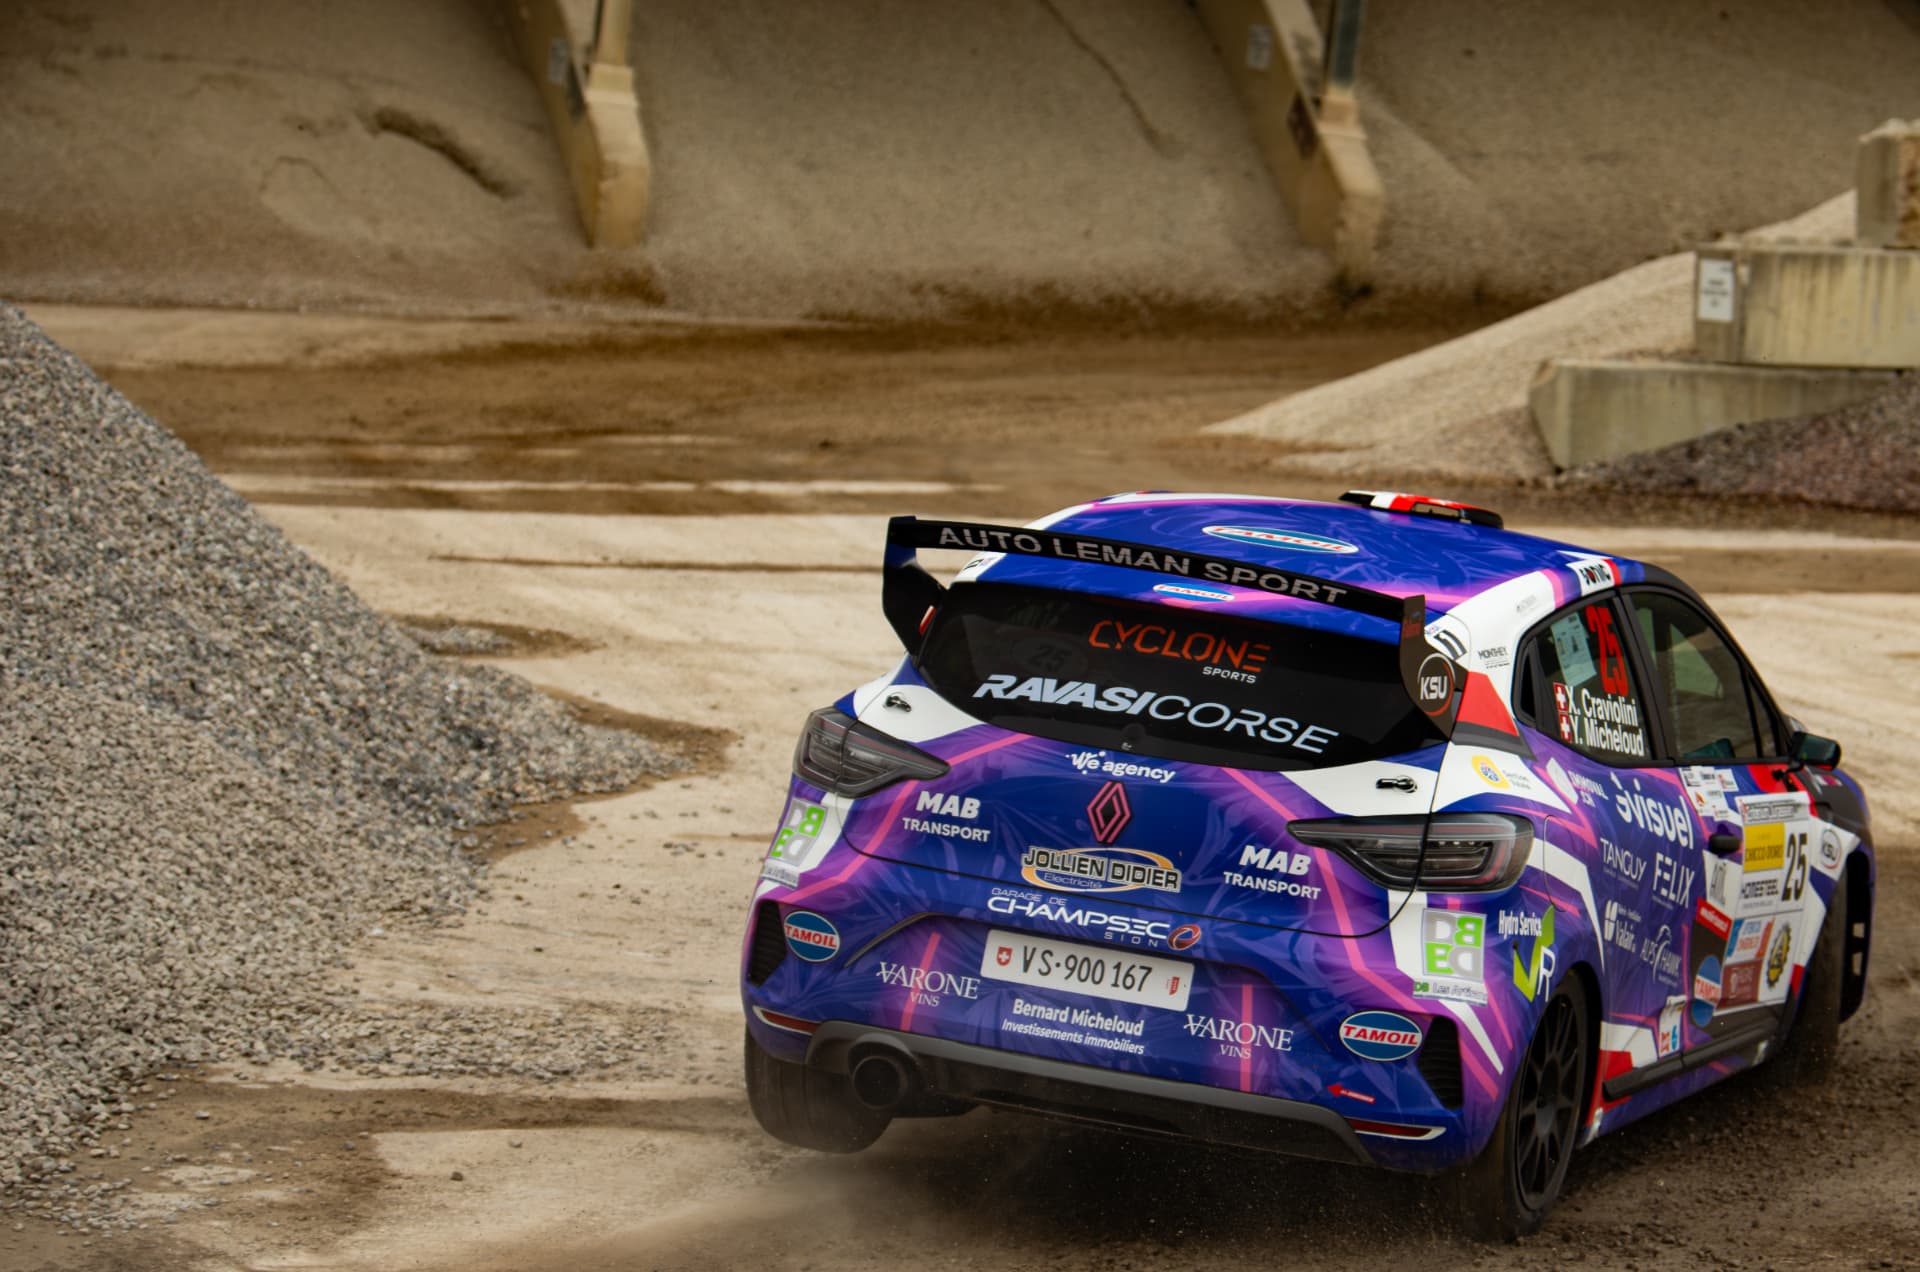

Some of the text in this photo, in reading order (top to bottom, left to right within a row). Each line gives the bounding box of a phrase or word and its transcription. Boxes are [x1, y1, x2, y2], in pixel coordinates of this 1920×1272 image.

[939, 527, 1348, 604] AUTO LEMAN SPORT
[1088, 619, 1272, 673] CYCLONE
[1585, 604, 1629, 696] 25
[1202, 665, 1257, 684] SPORTS
[1420, 675, 1448, 700] KSU
[1565, 685, 1639, 727] X. Craviolini
[1569, 714, 1645, 757] Y. Micheloud
[1102, 760, 1176, 783] agency
[915, 790, 981, 819] MAB
[902, 817, 991, 842] TRANSPORT
[1024, 849, 1178, 889] JOLLIEN DIDIER
[1239, 845, 1311, 876] MAB
[1600, 837, 1648, 882] TANGUY
[1781, 832, 1808, 901] 25
[991, 887, 1068, 906] GARAGE DE
[1223, 871, 1321, 900] TRANSPORT
[987, 896, 1171, 940] CHAMPSEC
[1498, 910, 1543, 940] Hydro Service
[784, 924, 838, 948] TAMOIL
[1103, 931, 1159, 948] SION
[876, 961, 980, 999] VARONE
[909, 991, 940, 1007] VINS
[1012, 998, 1145, 1037] Bernard Micheloud
[1183, 1013, 1294, 1052] VARONE
[1002, 1018, 1145, 1056] Investissements immobiliers
[1342, 1025, 1418, 1046] TAMOIL
[1220, 1043, 1252, 1060] VINS
